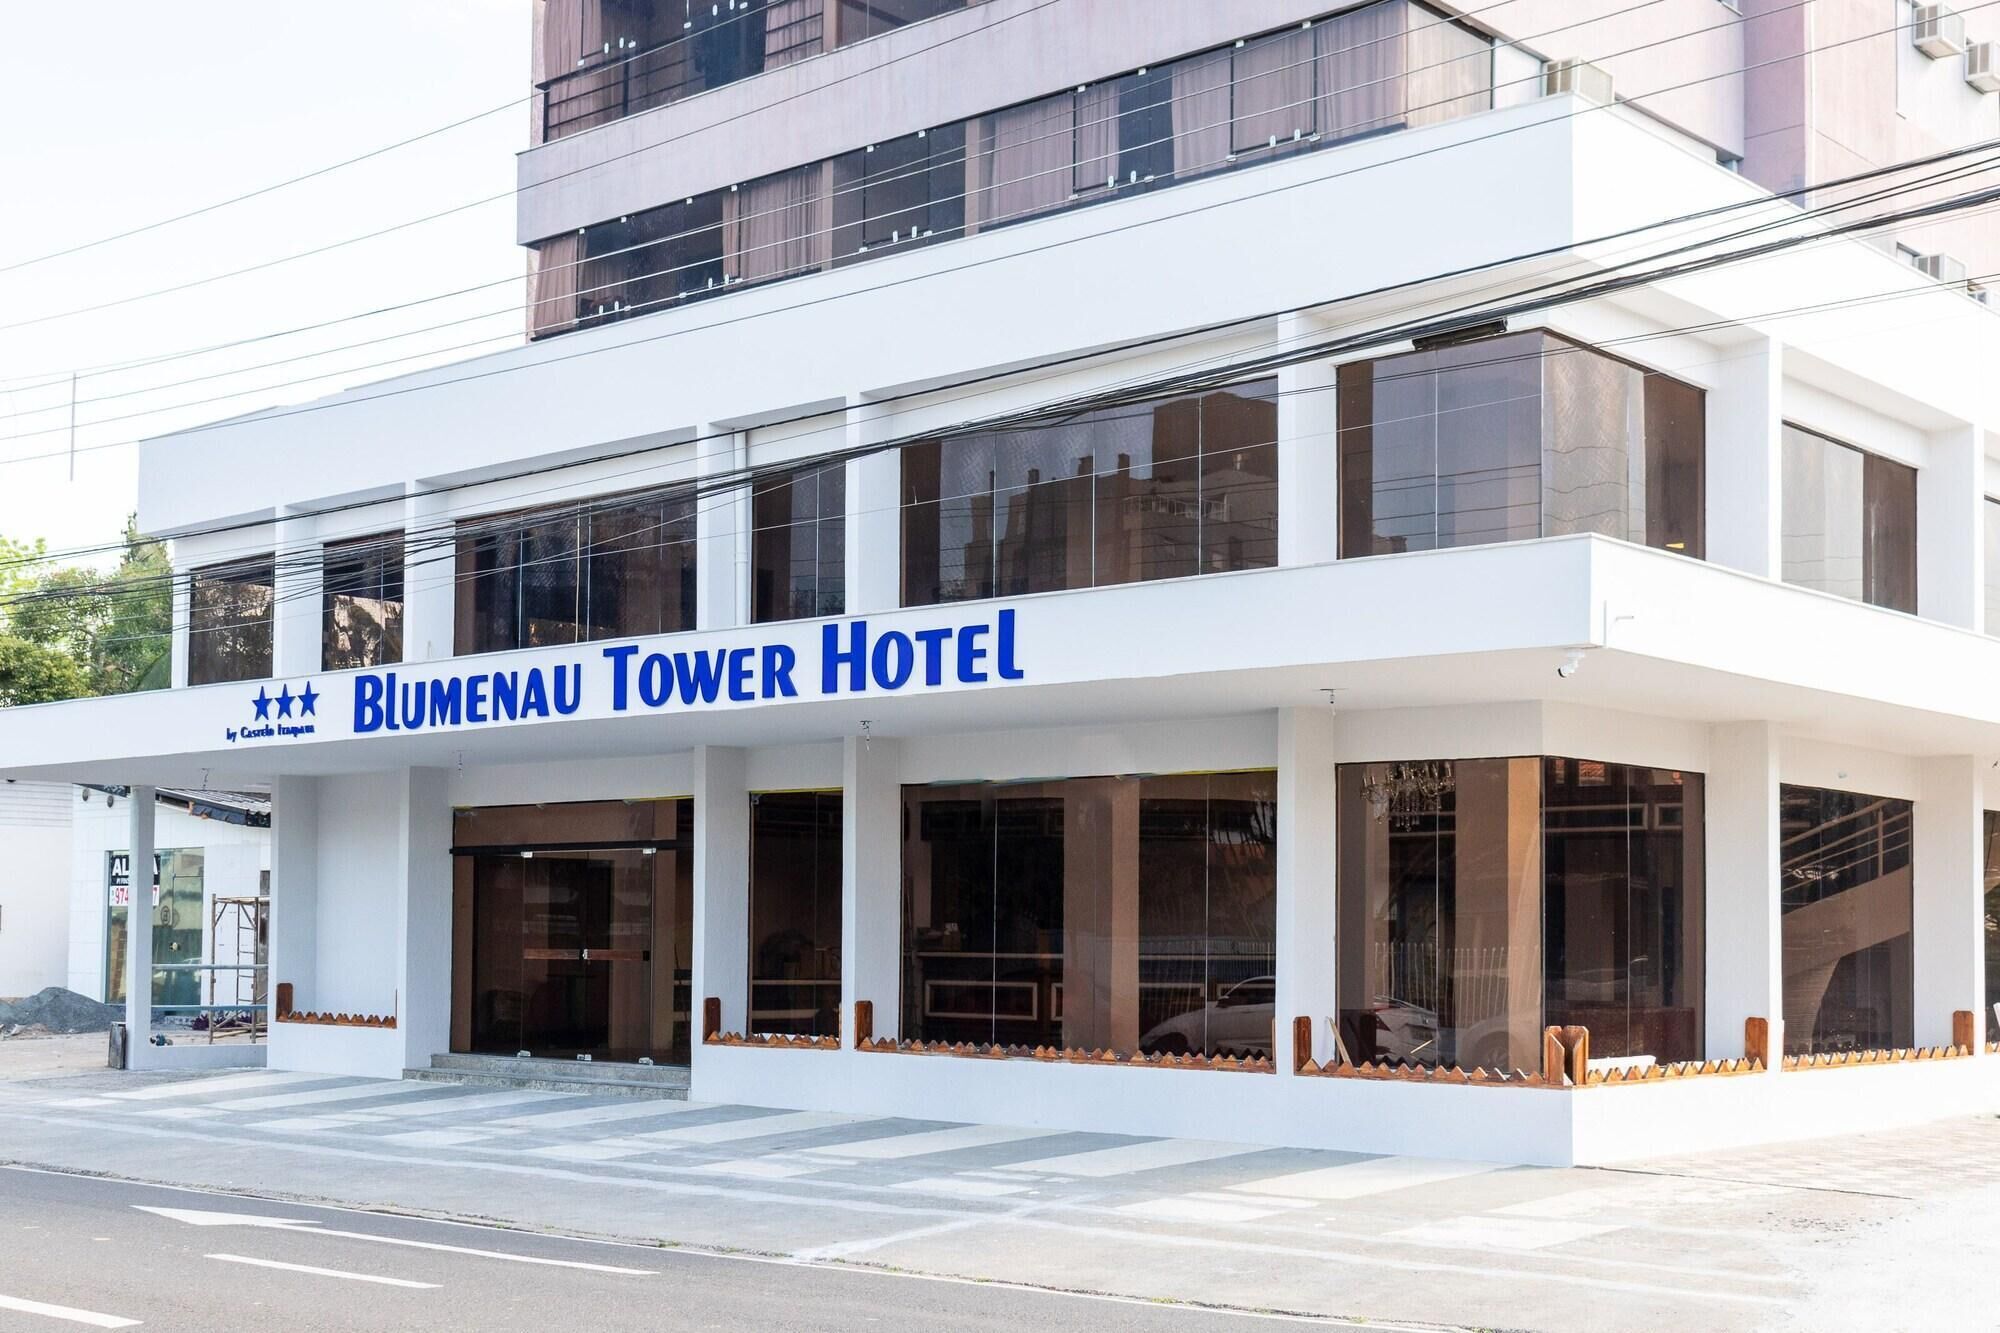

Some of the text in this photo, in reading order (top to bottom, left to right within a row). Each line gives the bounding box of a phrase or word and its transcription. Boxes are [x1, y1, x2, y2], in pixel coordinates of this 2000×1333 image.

[352, 608, 1025, 734] BLUMENAU TOWER HOTEL
